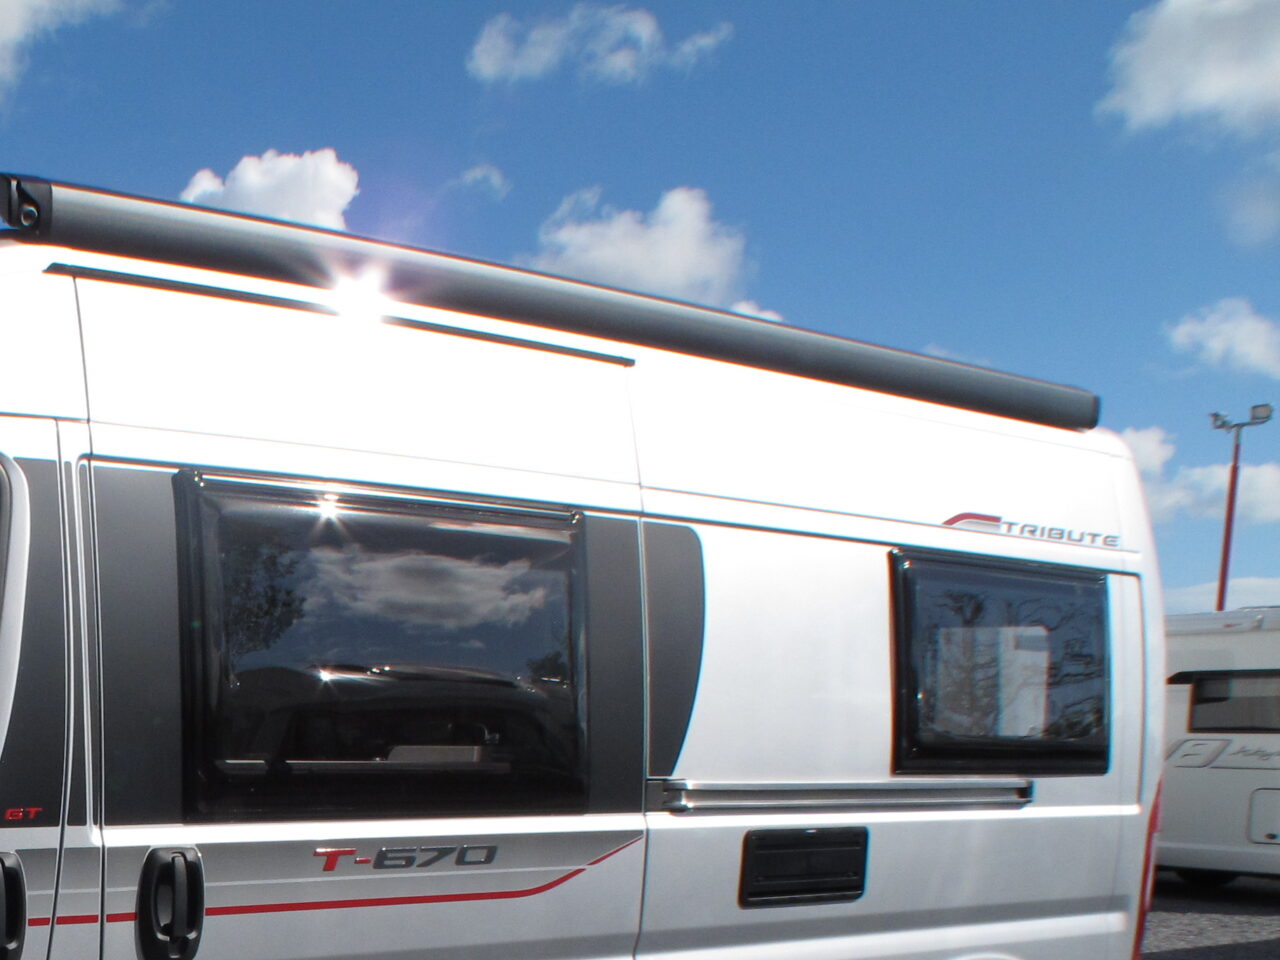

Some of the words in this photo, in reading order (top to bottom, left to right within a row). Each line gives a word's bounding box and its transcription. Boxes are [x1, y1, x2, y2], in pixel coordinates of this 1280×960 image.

[1002, 521, 1121, 547] TRIBUTE
[3, 807, 43, 820] GT
[314, 845, 498, 871] T-670
